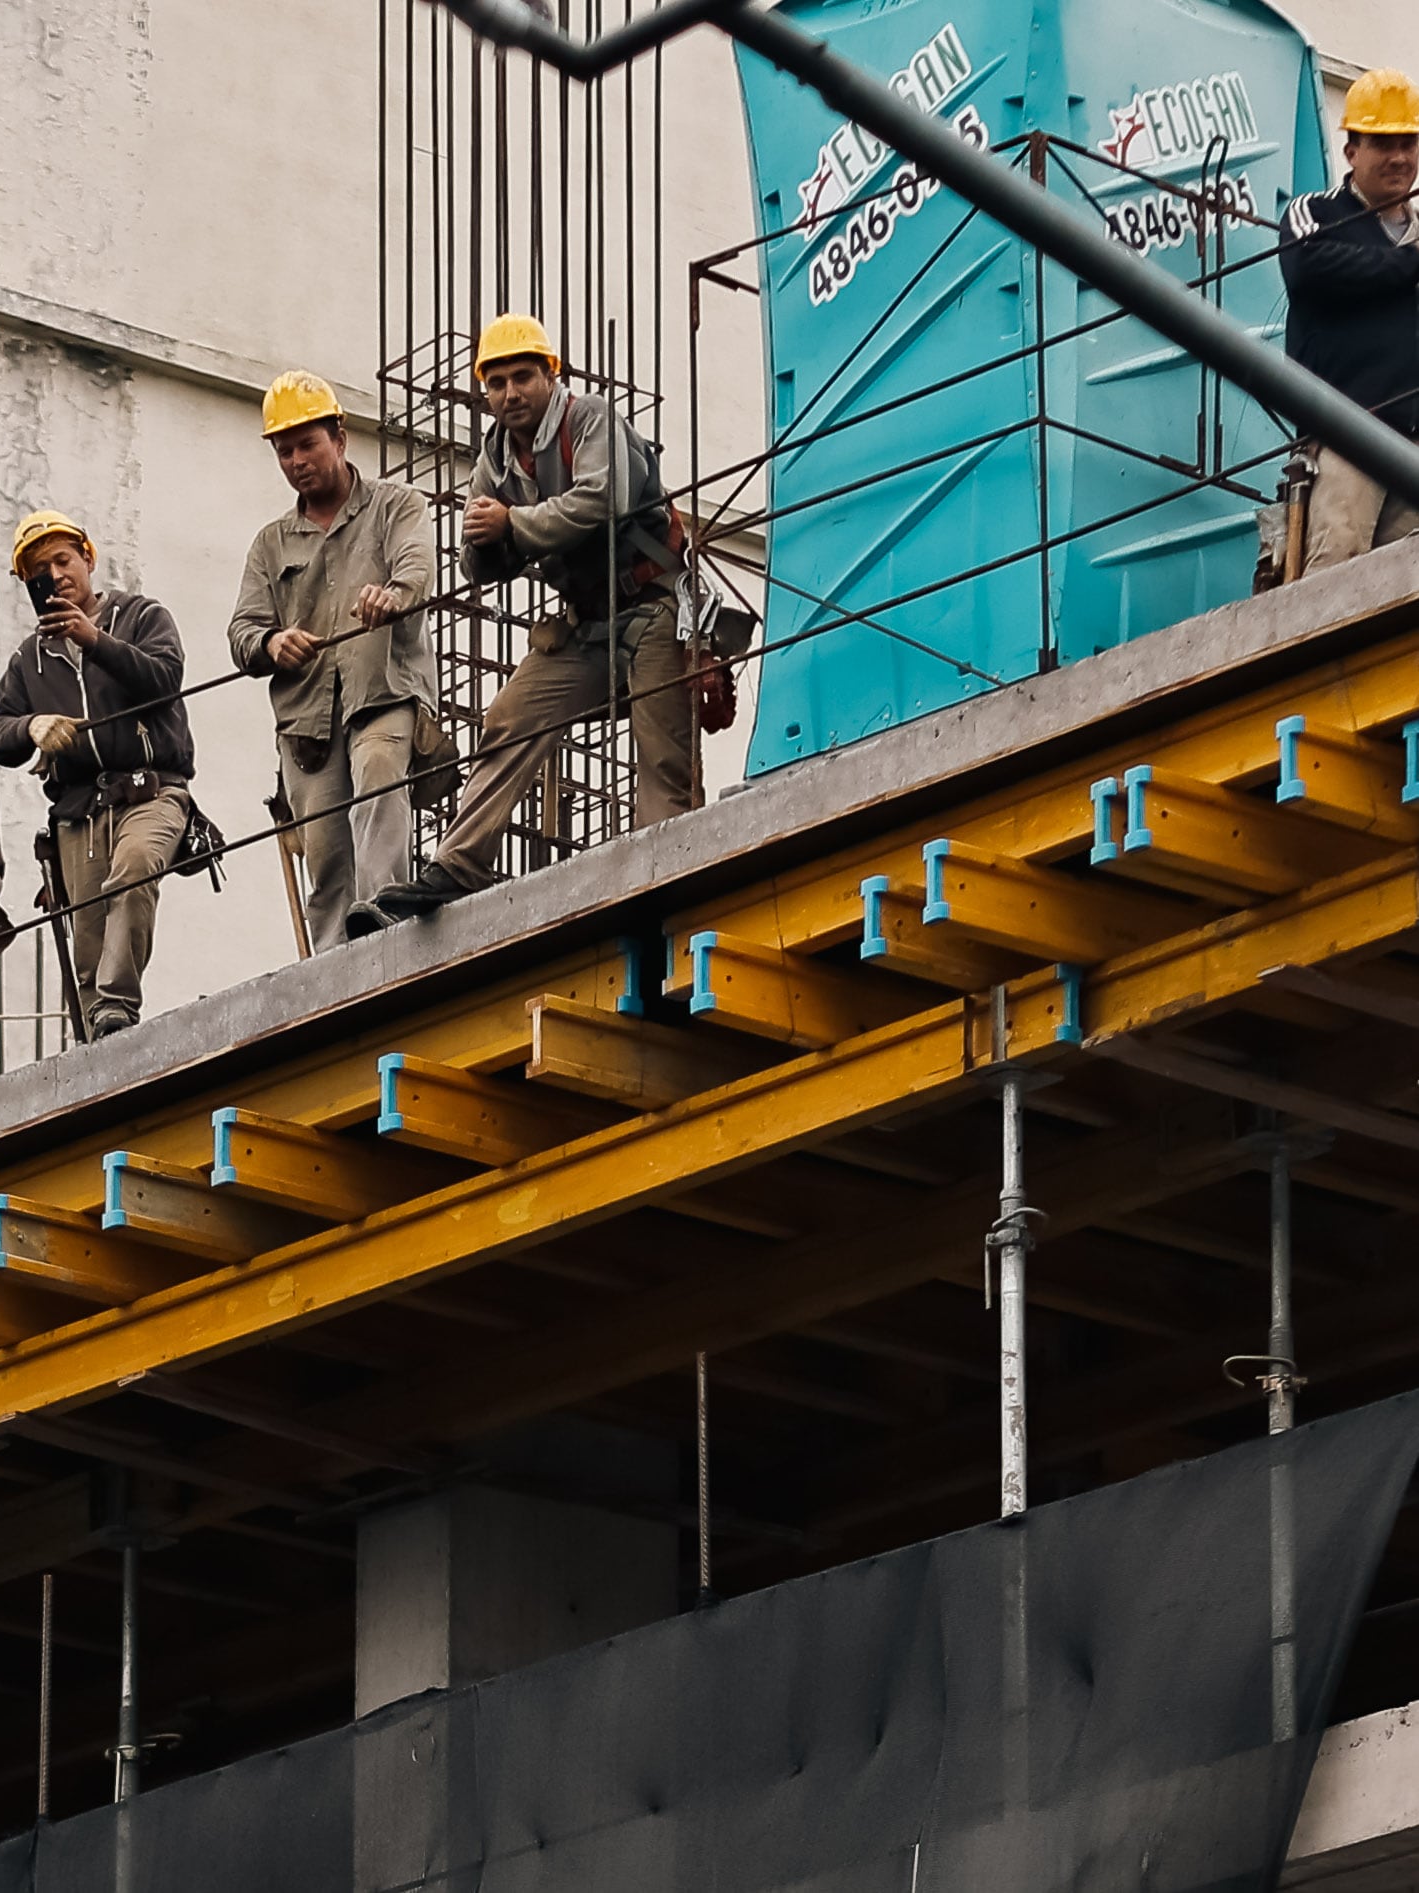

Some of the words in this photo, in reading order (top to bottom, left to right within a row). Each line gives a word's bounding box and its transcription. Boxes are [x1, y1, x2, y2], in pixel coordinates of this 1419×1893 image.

[830, 28, 969, 187] ECSAN
[1144, 75, 1257, 157] ECOSAN
[812, 110, 984, 299] 4846-05
